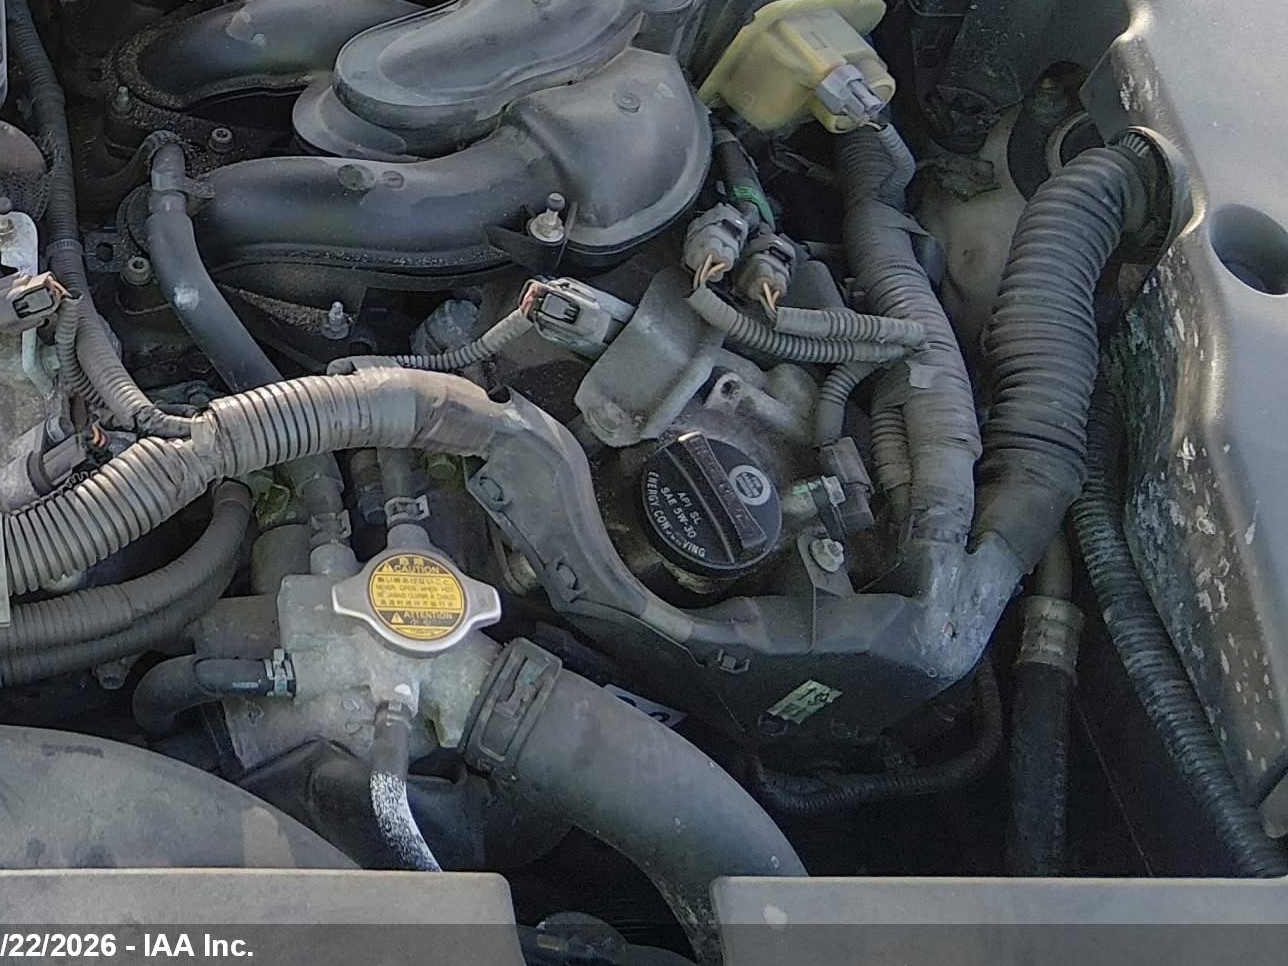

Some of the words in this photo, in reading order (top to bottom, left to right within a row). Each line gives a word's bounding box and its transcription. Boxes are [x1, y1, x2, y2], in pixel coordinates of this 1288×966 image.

[646, 471, 660, 507] ENERGY
[660, 486, 678, 507] SAE
[673, 507, 698, 539] 5W-30
[677, 491, 692, 508] API
[689, 510, 703, 525] SL
[393, 564, 440, 574] CAUTION
[403, 610, 452, 619] ATTENTION
